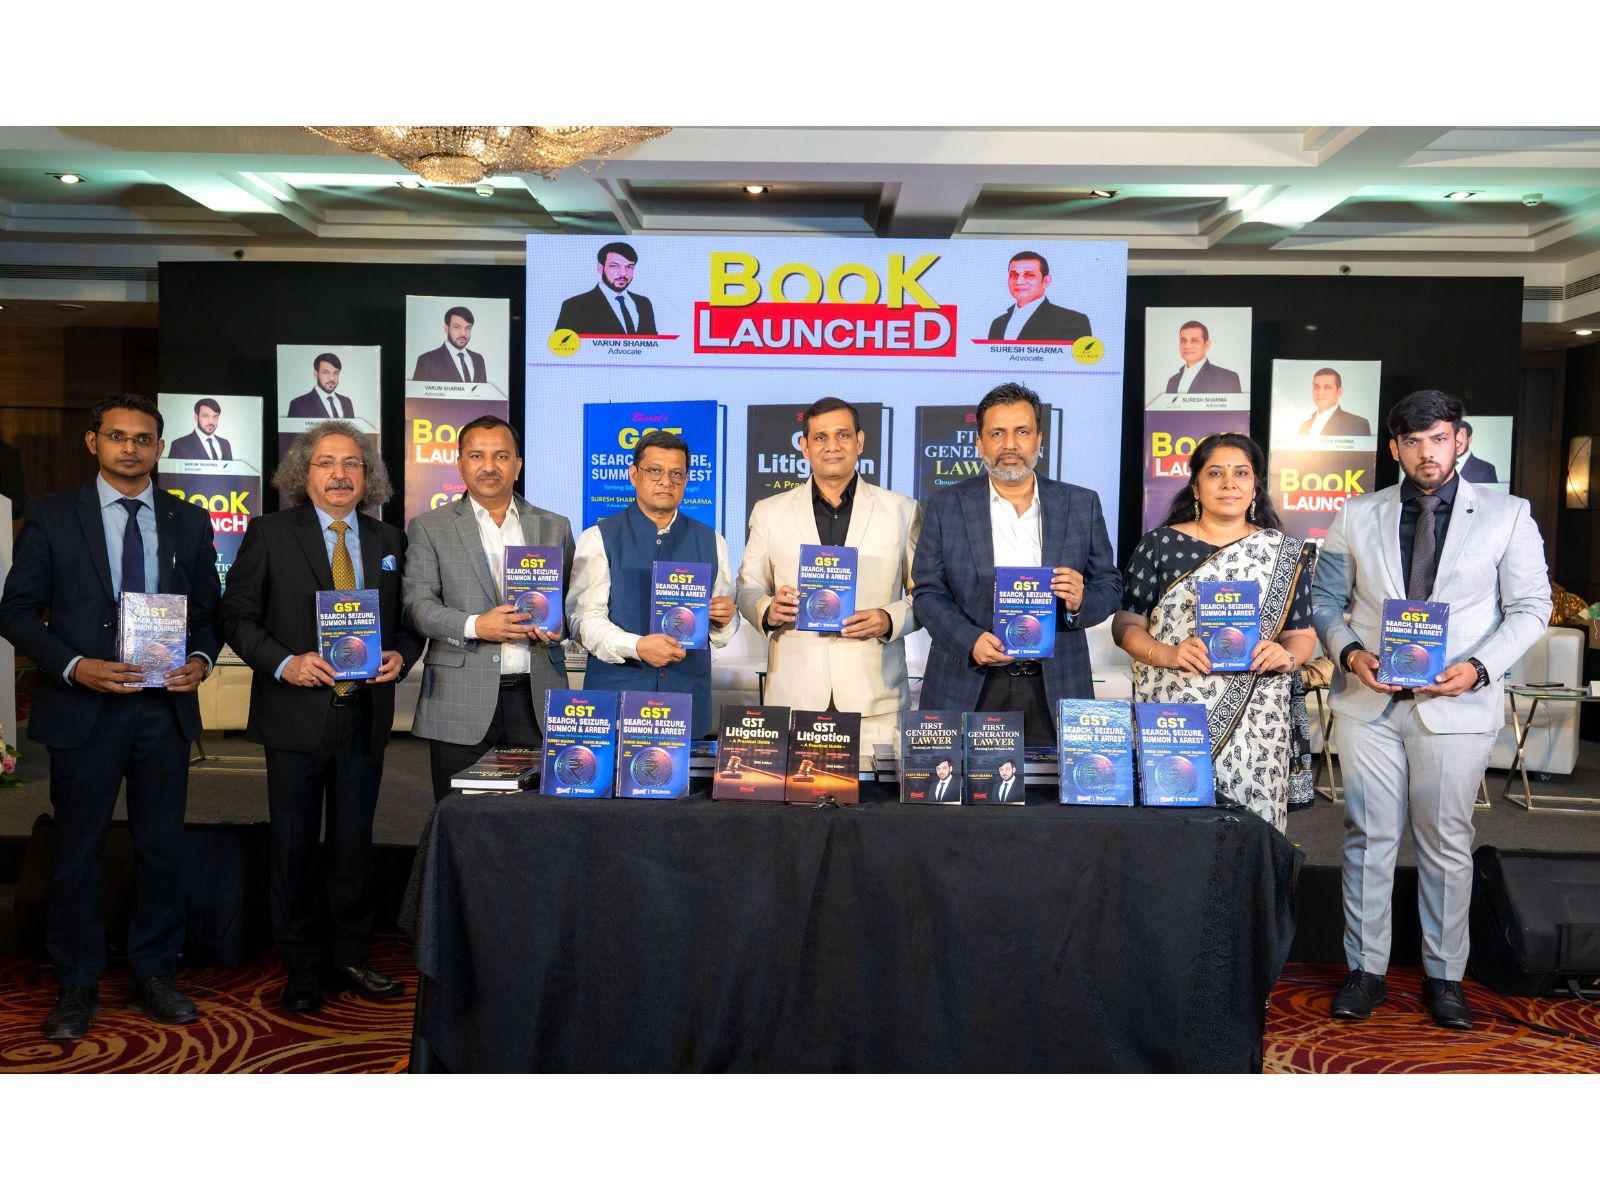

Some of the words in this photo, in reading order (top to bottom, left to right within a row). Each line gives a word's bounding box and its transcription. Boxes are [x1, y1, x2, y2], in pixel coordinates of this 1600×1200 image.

[413, 418, 464, 444] BO
[1152, 432, 1209, 457] BO
[416, 445, 459, 463] LAU
[591, 454, 633, 465] SEARC
[936, 461, 984, 475] LAW
[1156, 458, 1192, 476] LAU
[592, 469, 628, 480] SUMM
[688, 470, 712, 481] EST
[1283, 492, 1351, 511] LAUNC
[210, 514, 248, 532] NCH
[520, 559, 545, 568] GST
[815, 557, 840, 566] GST
[669, 574, 694, 583] GST
[1013, 581, 1039, 591] GST
[1215, 593, 1241, 603] GST
[334, 603, 360, 612] GST
[1401, 612, 1429, 622] GST
[1414, 623, 1443, 631] SEIZURE,
[565, 705, 595, 717] GST
[640, 707, 670, 719] GST
[547, 717, 577, 725] SEARCH,
[579, 718, 610, 727] SEIZURE,
[624, 719, 653, 727] SEARCH,
[655, 719, 686, 728] SEIZURE,
[742, 717, 764, 728] GST
[1079, 715, 1110, 726] GST
[1157, 717, 1186, 728] GST
[547, 724, 576, 733] SUMMON
[584, 726, 610, 734] ARREST
[624, 726, 652, 734] SUMMON
[660, 727, 685, 735] ARREST
[726, 727, 778, 739] Litigation
[813, 723, 836, 733] GST
[906, 729, 957, 737] GENERATION
[797, 731, 850, 743] Litigation
[973, 738, 1014, 746] LAWYER
